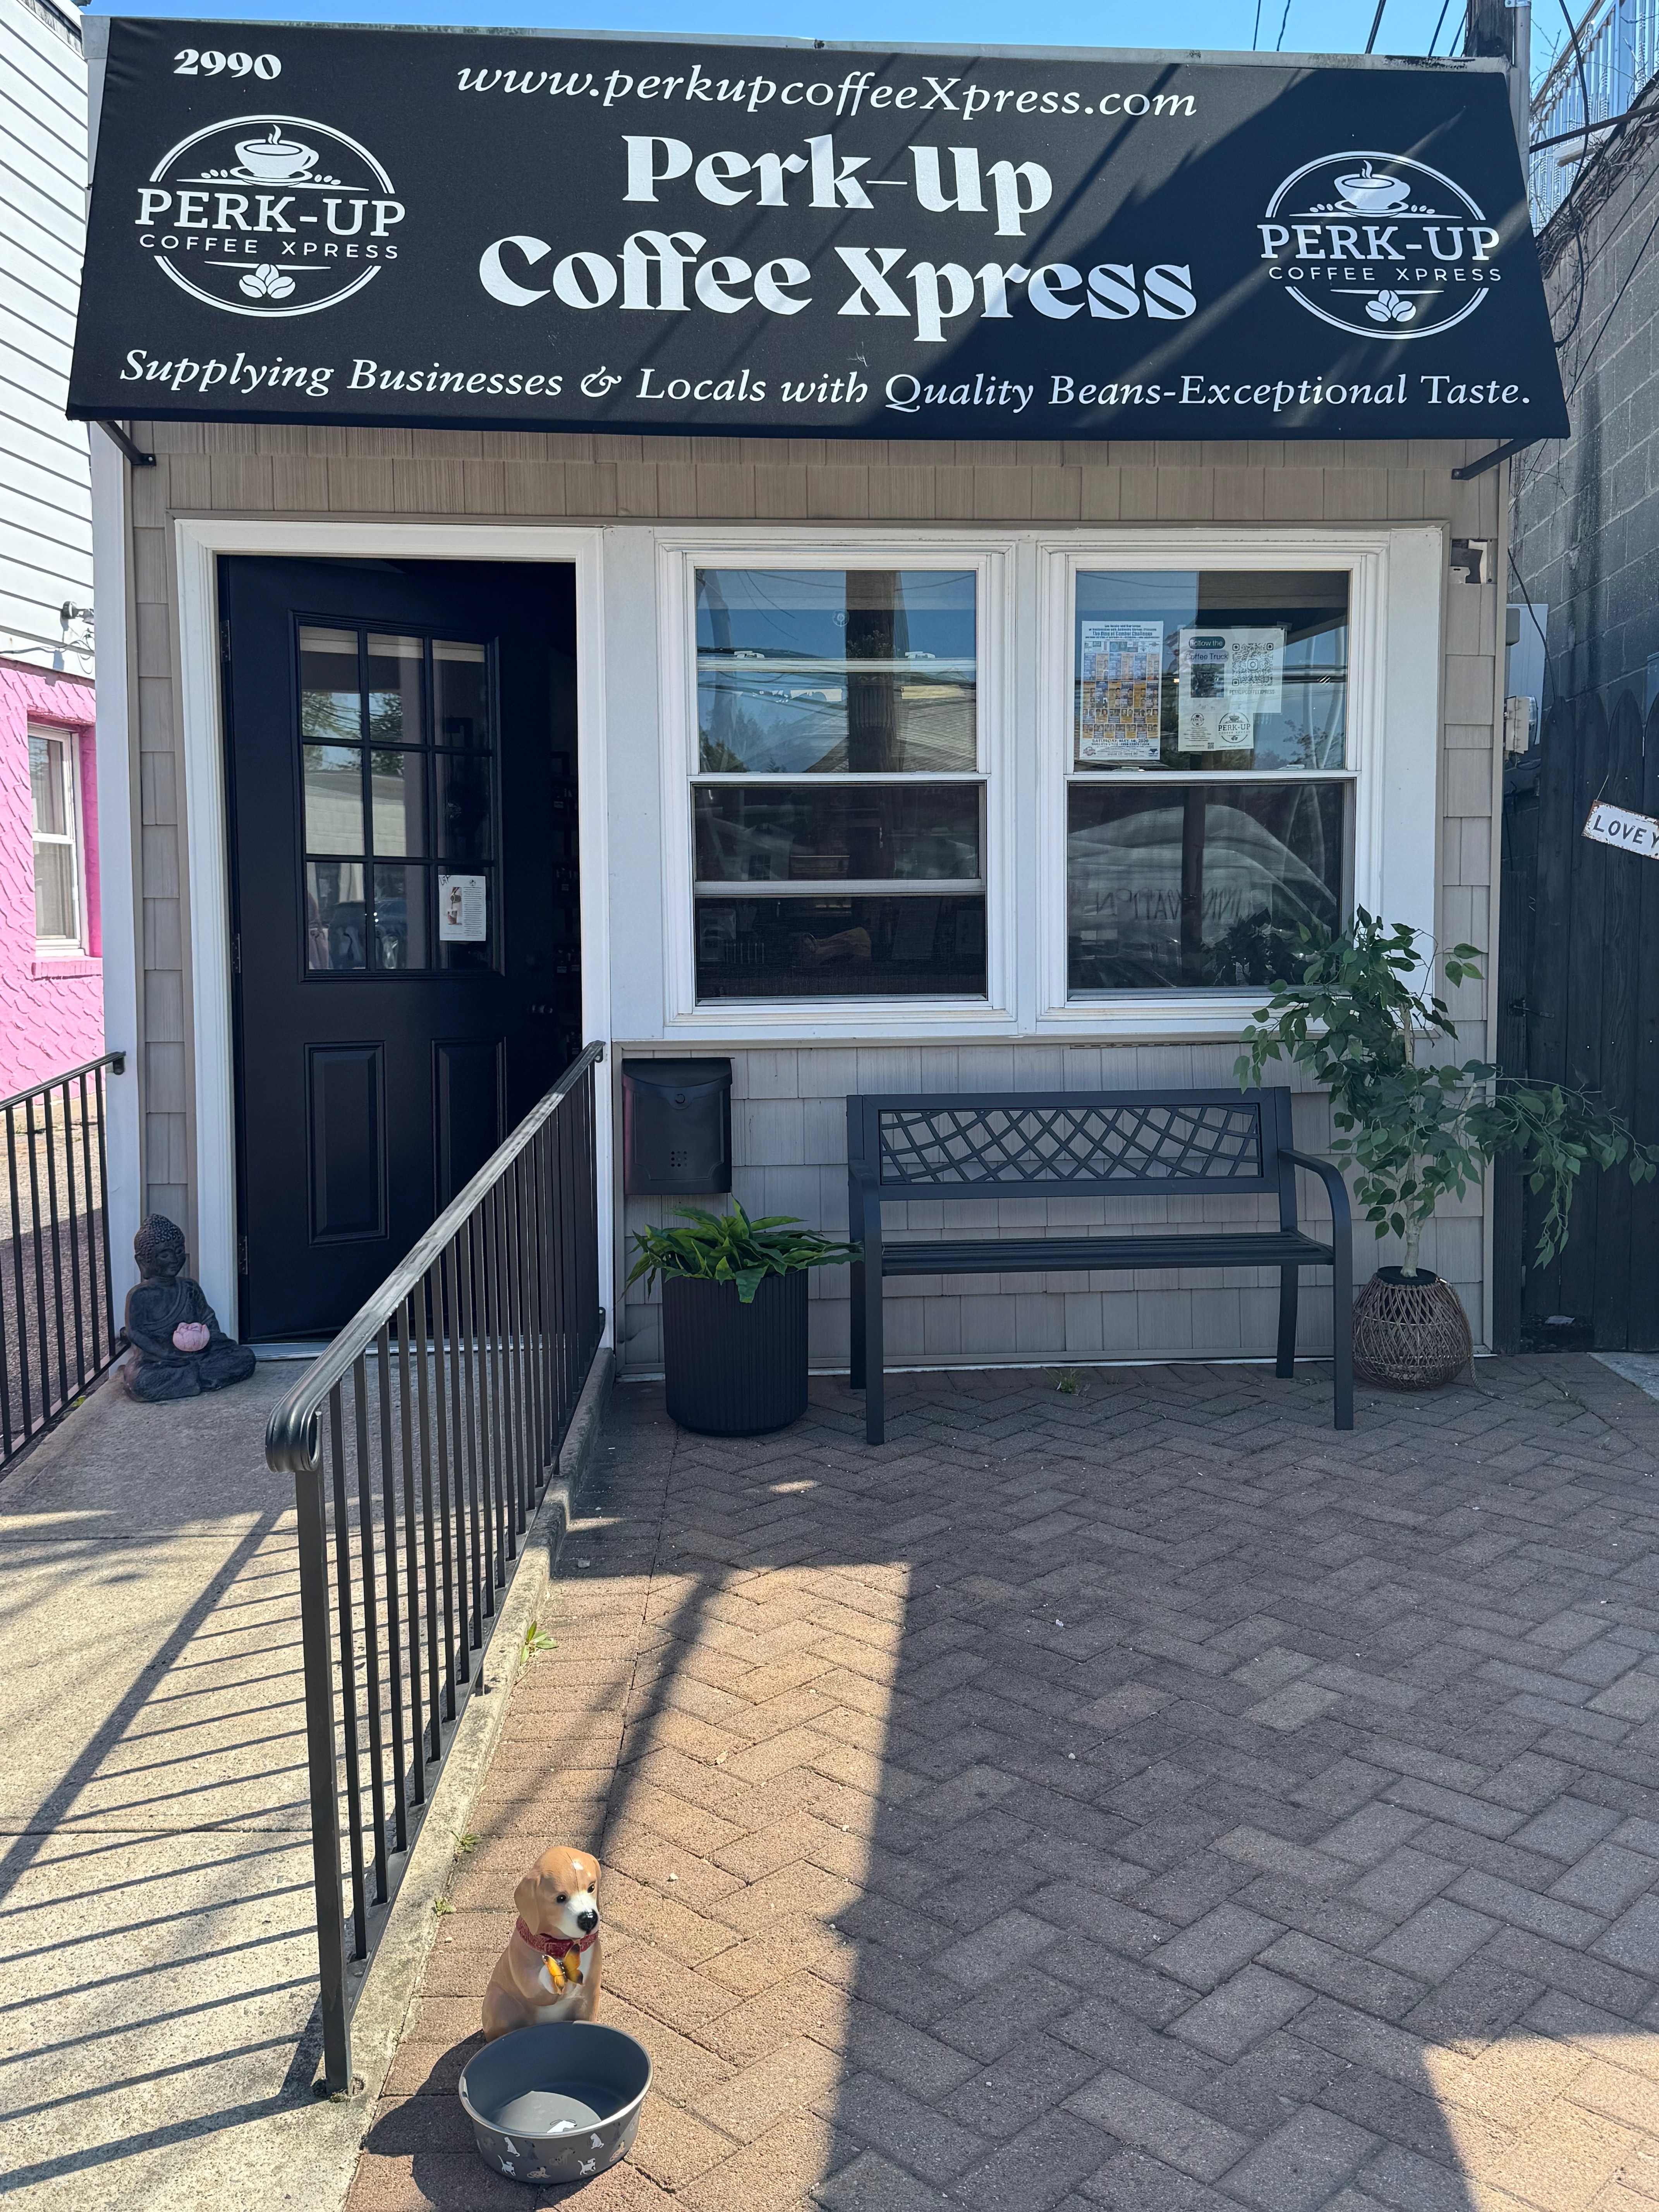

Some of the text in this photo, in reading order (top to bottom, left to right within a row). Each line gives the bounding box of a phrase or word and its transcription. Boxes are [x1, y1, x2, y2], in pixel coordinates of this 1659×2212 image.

[173, 49, 282, 80] 2990
[457, 64, 1197, 120] www.perkupcoffeeXpress.com
[621, 134, 1052, 236] Perk-Up
[135, 188, 405, 237] PERK-UP
[139, 234, 398, 259] COFFEE XPRESS
[1257, 224, 1499, 261] PERK-UP
[479, 230, 1197, 342] Coffee Xpress
[1269, 266, 1501, 281] COFFEE XPRESS
[120, 349, 1530, 413] Supplying Businesses & Locals with Quality Beans-Exceptional Taste.
[1593, 815, 1647, 844] LOVE
